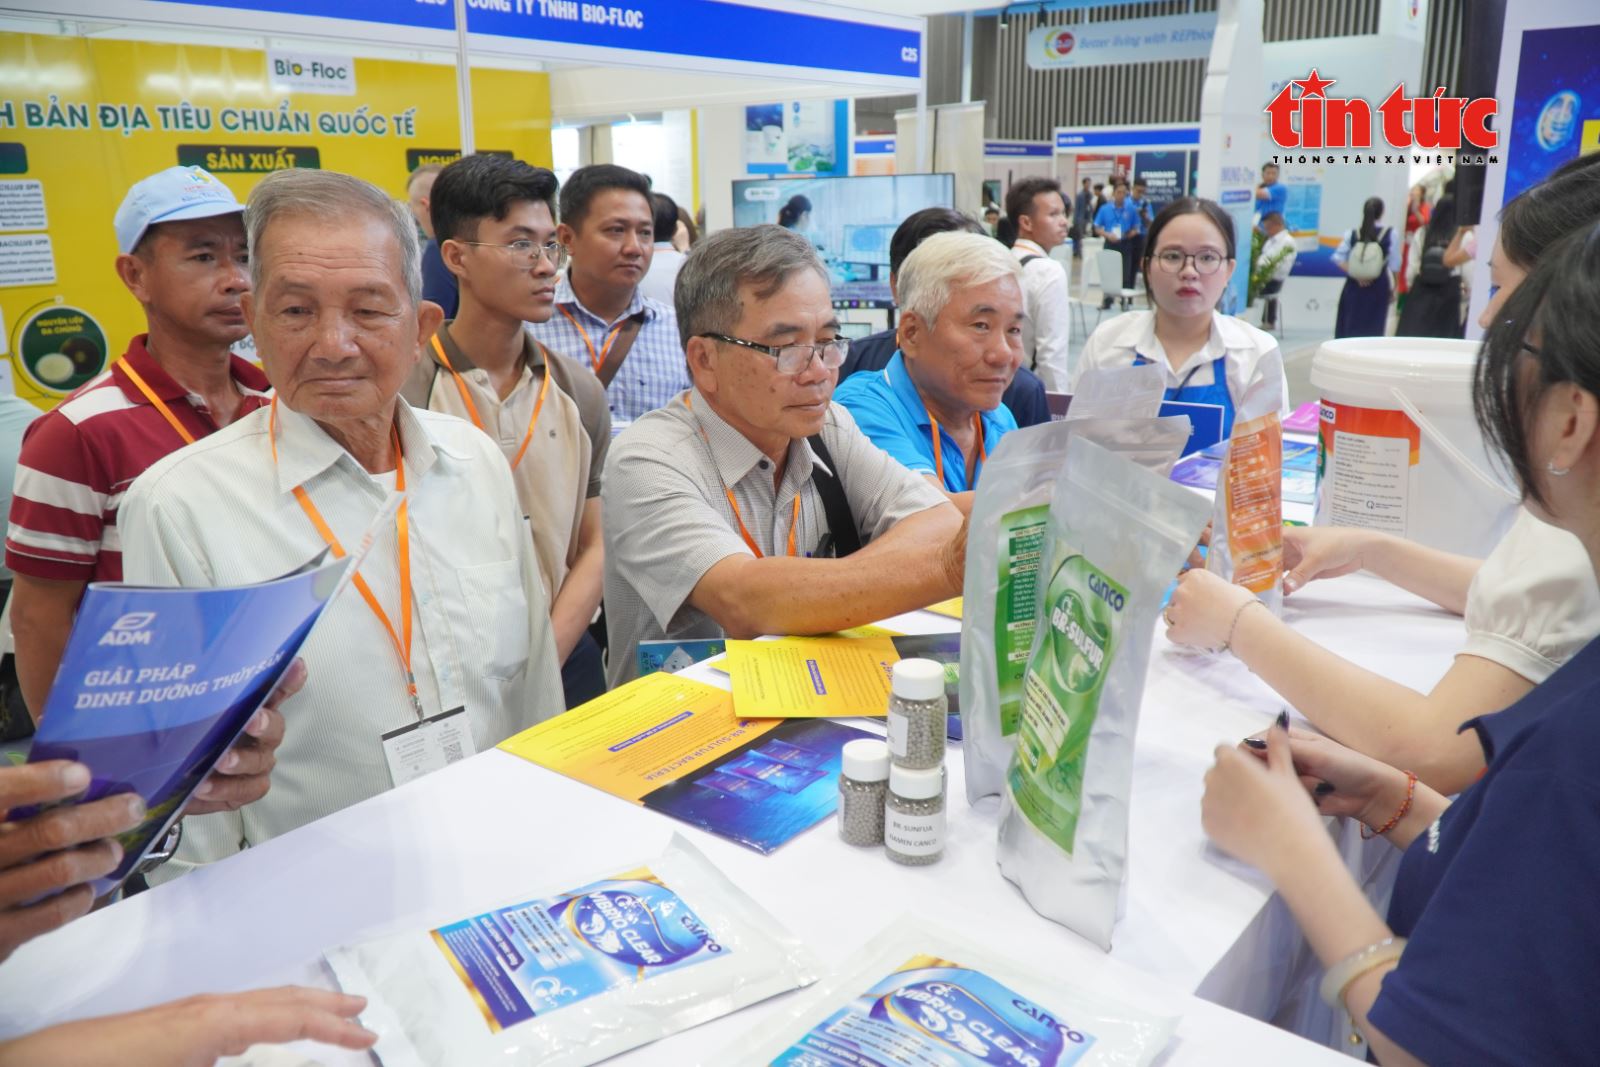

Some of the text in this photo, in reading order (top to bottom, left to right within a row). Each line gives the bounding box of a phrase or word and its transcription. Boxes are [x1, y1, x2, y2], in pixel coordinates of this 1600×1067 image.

[538, 1, 578, 21] TNHH
[582, 4, 644, 29] BIO-FLOC
[901, 46, 918, 62] C25
[274, 59, 347, 80] Bio-Floc
[25, 95, 90, 128] BẢN
[99, 104, 151, 136] ĐỊA
[157, 102, 212, 130] TIÊU
[221, 100, 310, 133] CHUẨN
[318, 106, 387, 135] QUỐC
[393, 108, 417, 136] TẾ
[206, 147, 296, 170] SẢN XUẤT
[1088, 573, 1125, 612] canco
[97, 630, 152, 646] ADM
[1052, 606, 1104, 671] BR-SULFUR
[84, 662, 196, 687] GIẢI PHÁP
[74, 692, 136, 709] DINH
[137, 681, 207, 705] DƯỠNG
[588, 890, 664, 965] VIBRIO CLEAR
[895, 987, 1042, 1067] VIBRIO CLEAR
[1012, 998, 1085, 1044] canco
